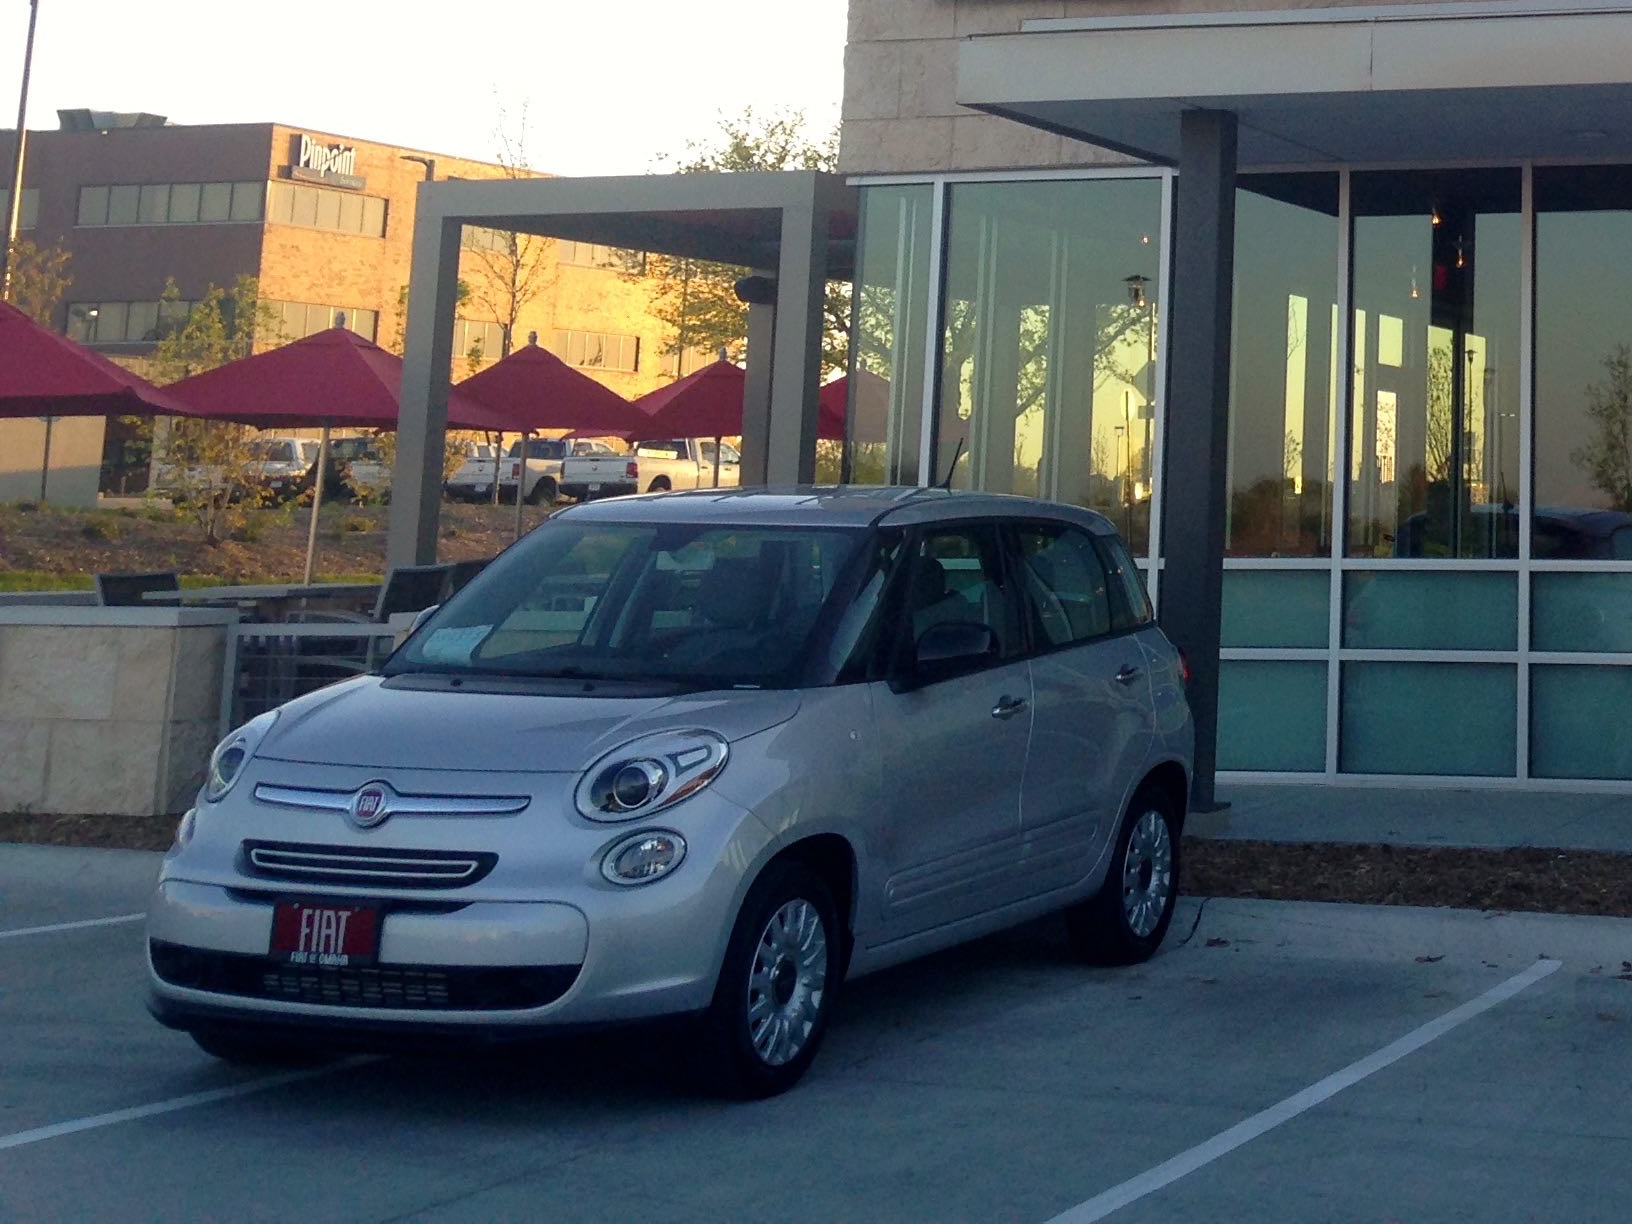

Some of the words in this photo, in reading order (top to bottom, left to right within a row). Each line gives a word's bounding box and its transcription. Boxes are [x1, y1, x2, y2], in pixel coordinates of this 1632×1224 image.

[300, 134, 356, 178] Pinpoint
[359, 795, 379, 811] FIAT
[299, 908, 351, 953] FIAT
